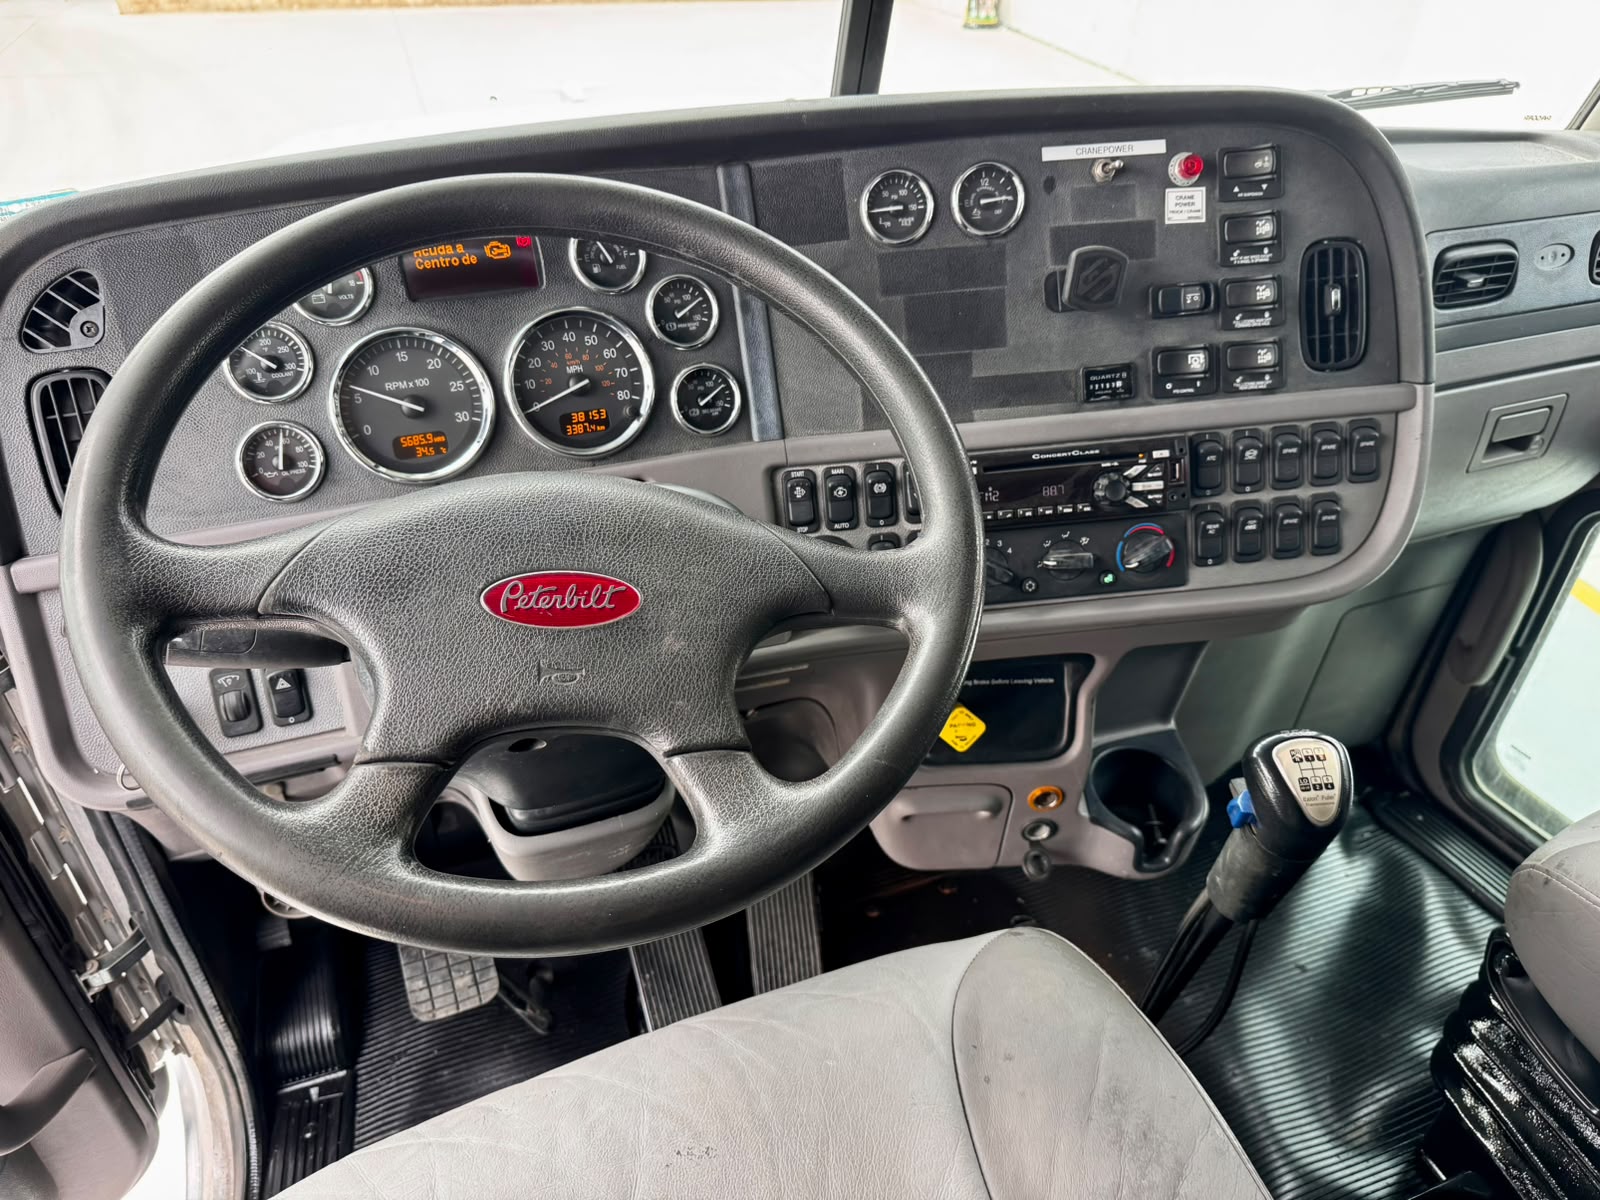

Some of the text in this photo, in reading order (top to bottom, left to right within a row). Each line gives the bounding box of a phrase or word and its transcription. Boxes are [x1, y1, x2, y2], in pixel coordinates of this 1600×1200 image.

[456, 244, 465, 253] a
[623, 250, 628, 259] F
[415, 253, 478, 270] Centro de
[259, 338, 271, 346] 200
[563, 332, 576, 342] 40
[585, 335, 598, 346] 50
[541, 340, 555, 351] 30
[396, 351, 408, 362] 15
[603, 348, 617, 359] 60
[426, 358, 441, 369] 20
[528, 358, 541, 368] 20
[367, 365, 379, 376] 10
[566, 365, 583, 374] MPH
[614, 367, 628, 378] 70
[385, 381, 407, 391] RPM
[415, 377, 429, 387] 100
[449, 381, 464, 392] 25
[525, 379, 536, 389] 10
[354, 393, 362, 404] 5
[617, 390, 630, 400] 80
[455, 411, 470, 422] 30
[571, 409, 607, 423] 38153
[363, 425, 372, 435] 0
[256, 451, 265, 459] 20
[500, 580, 627, 613] Peterbilt
